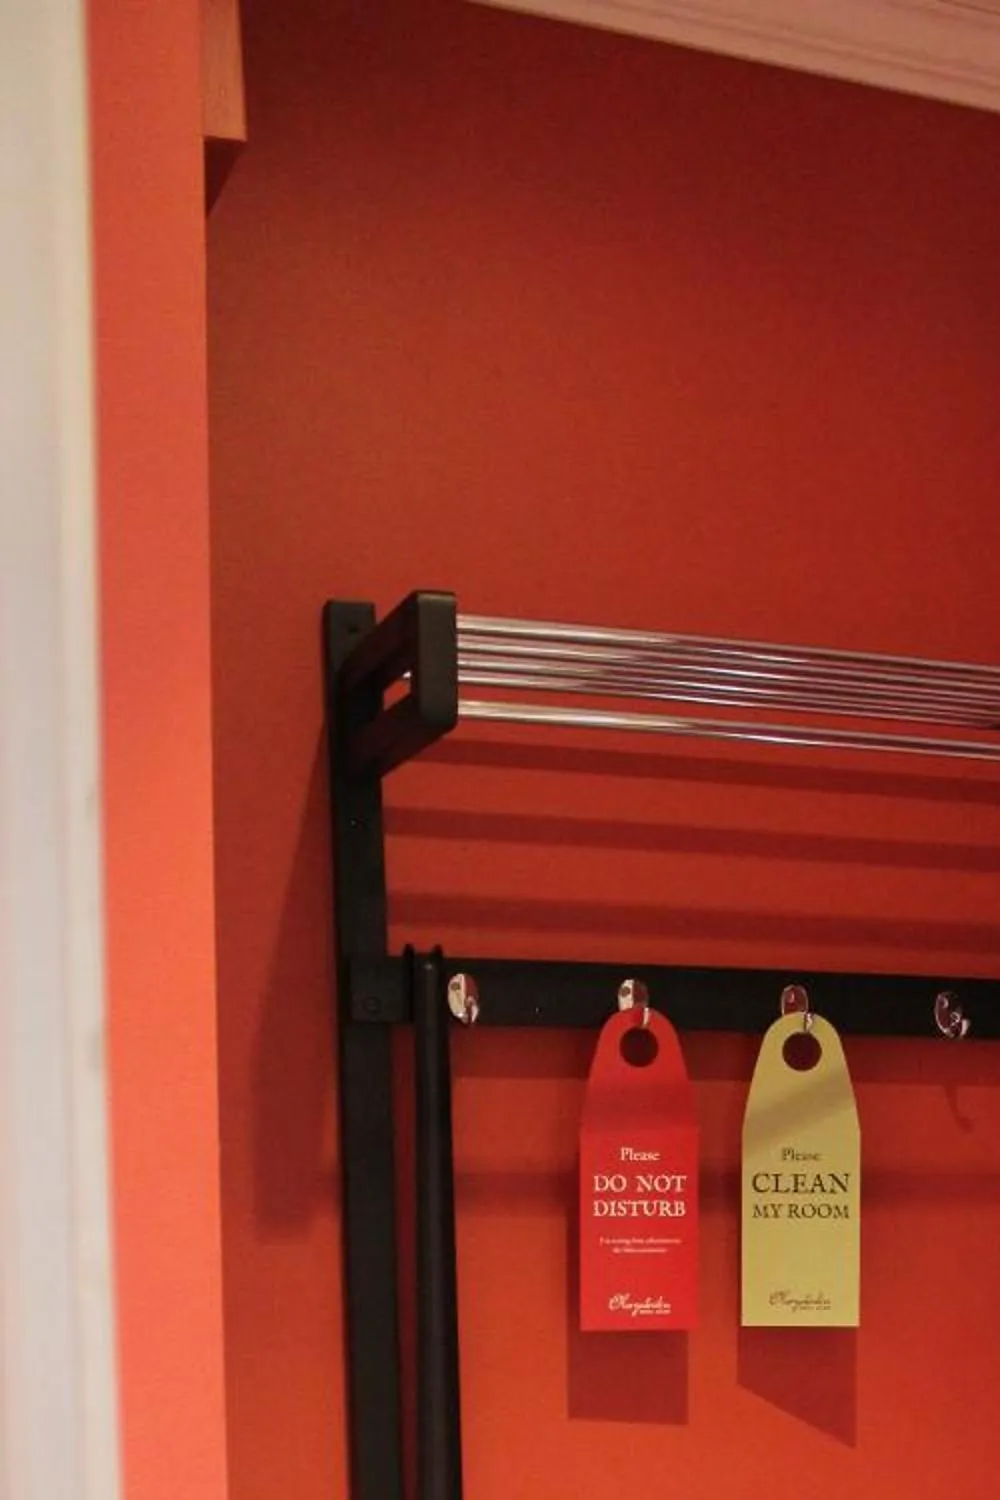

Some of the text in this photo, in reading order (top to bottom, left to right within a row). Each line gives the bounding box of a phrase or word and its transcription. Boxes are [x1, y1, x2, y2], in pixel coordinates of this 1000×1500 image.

[620, 1147, 661, 1162] Please
[782, 1147, 823, 1162] Please
[593, 1174, 688, 1193] DO NOT
[752, 1173, 850, 1194] CLEAN
[593, 1200, 687, 1217] DISTURB
[752, 1203, 849, 1219] MY ROOM
